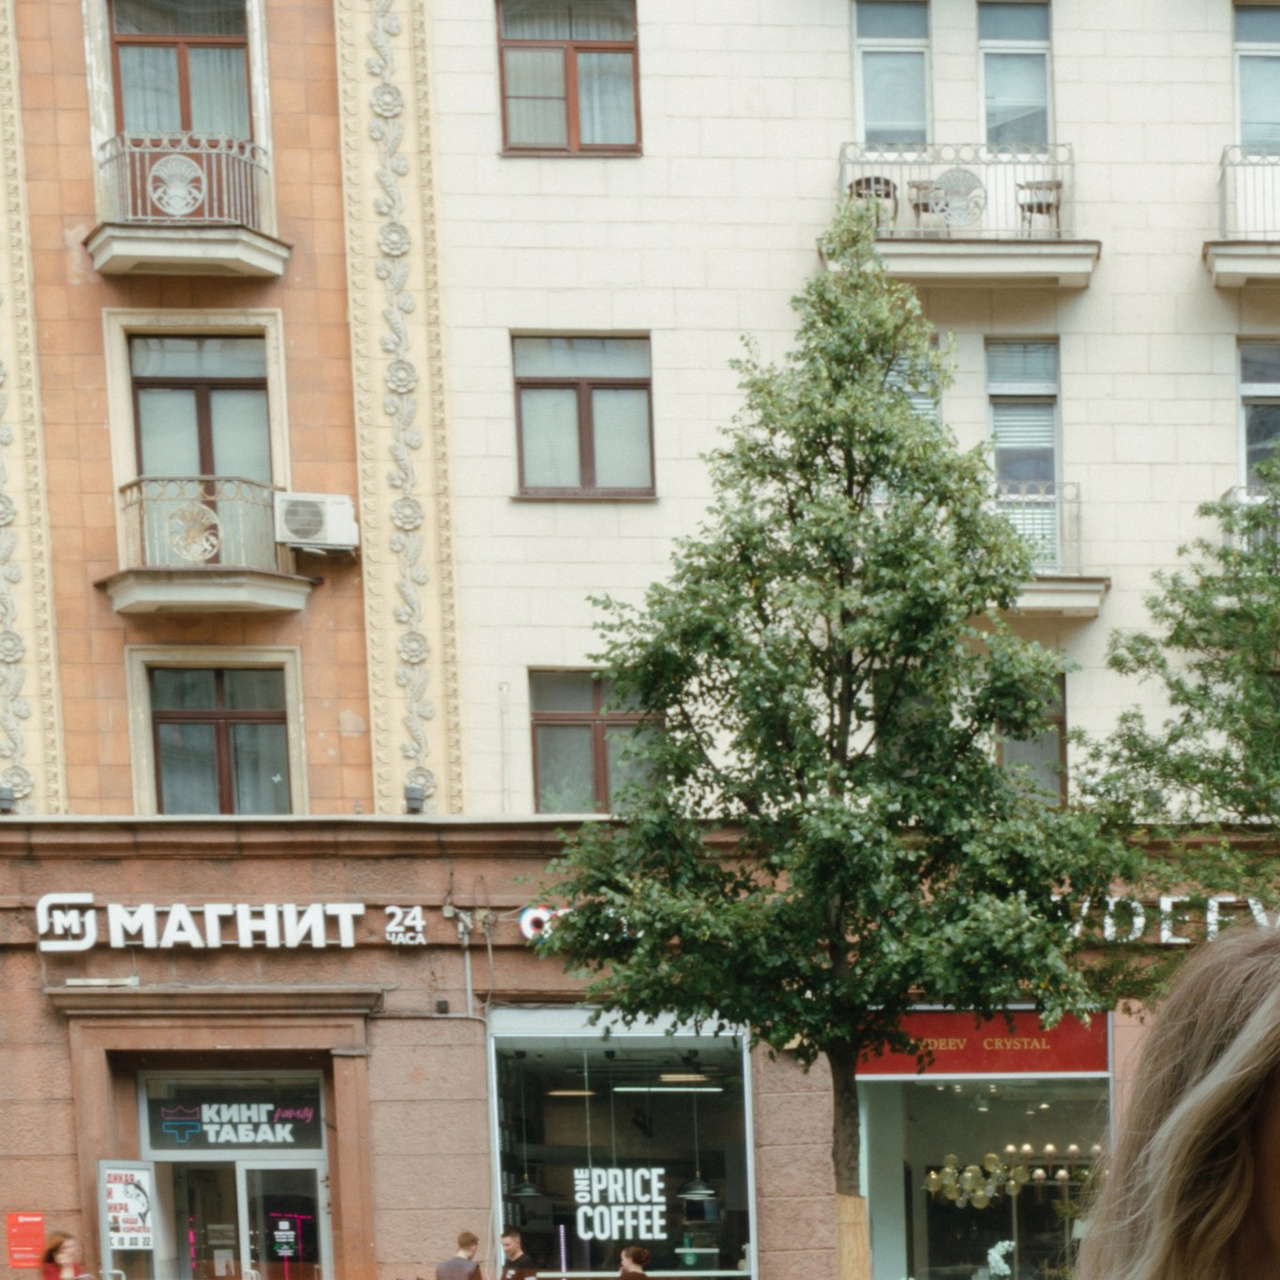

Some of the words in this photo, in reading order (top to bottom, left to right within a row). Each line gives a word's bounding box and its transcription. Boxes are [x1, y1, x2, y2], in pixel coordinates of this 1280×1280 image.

[107, 903, 365, 949] МАГНИТ
[384, 905, 426, 932] 24
[385, 932, 427, 945] ЧАСА
[983, 1038, 1050, 1050] CRYSTAL
[201, 1103, 275, 1123] КИНГ
[202, 1123, 295, 1143] ТАБАК
[574, 1168, 591, 1203] ONE
[591, 1167, 667, 1203] PRICE
[576, 1204, 668, 1240] COFFEE
